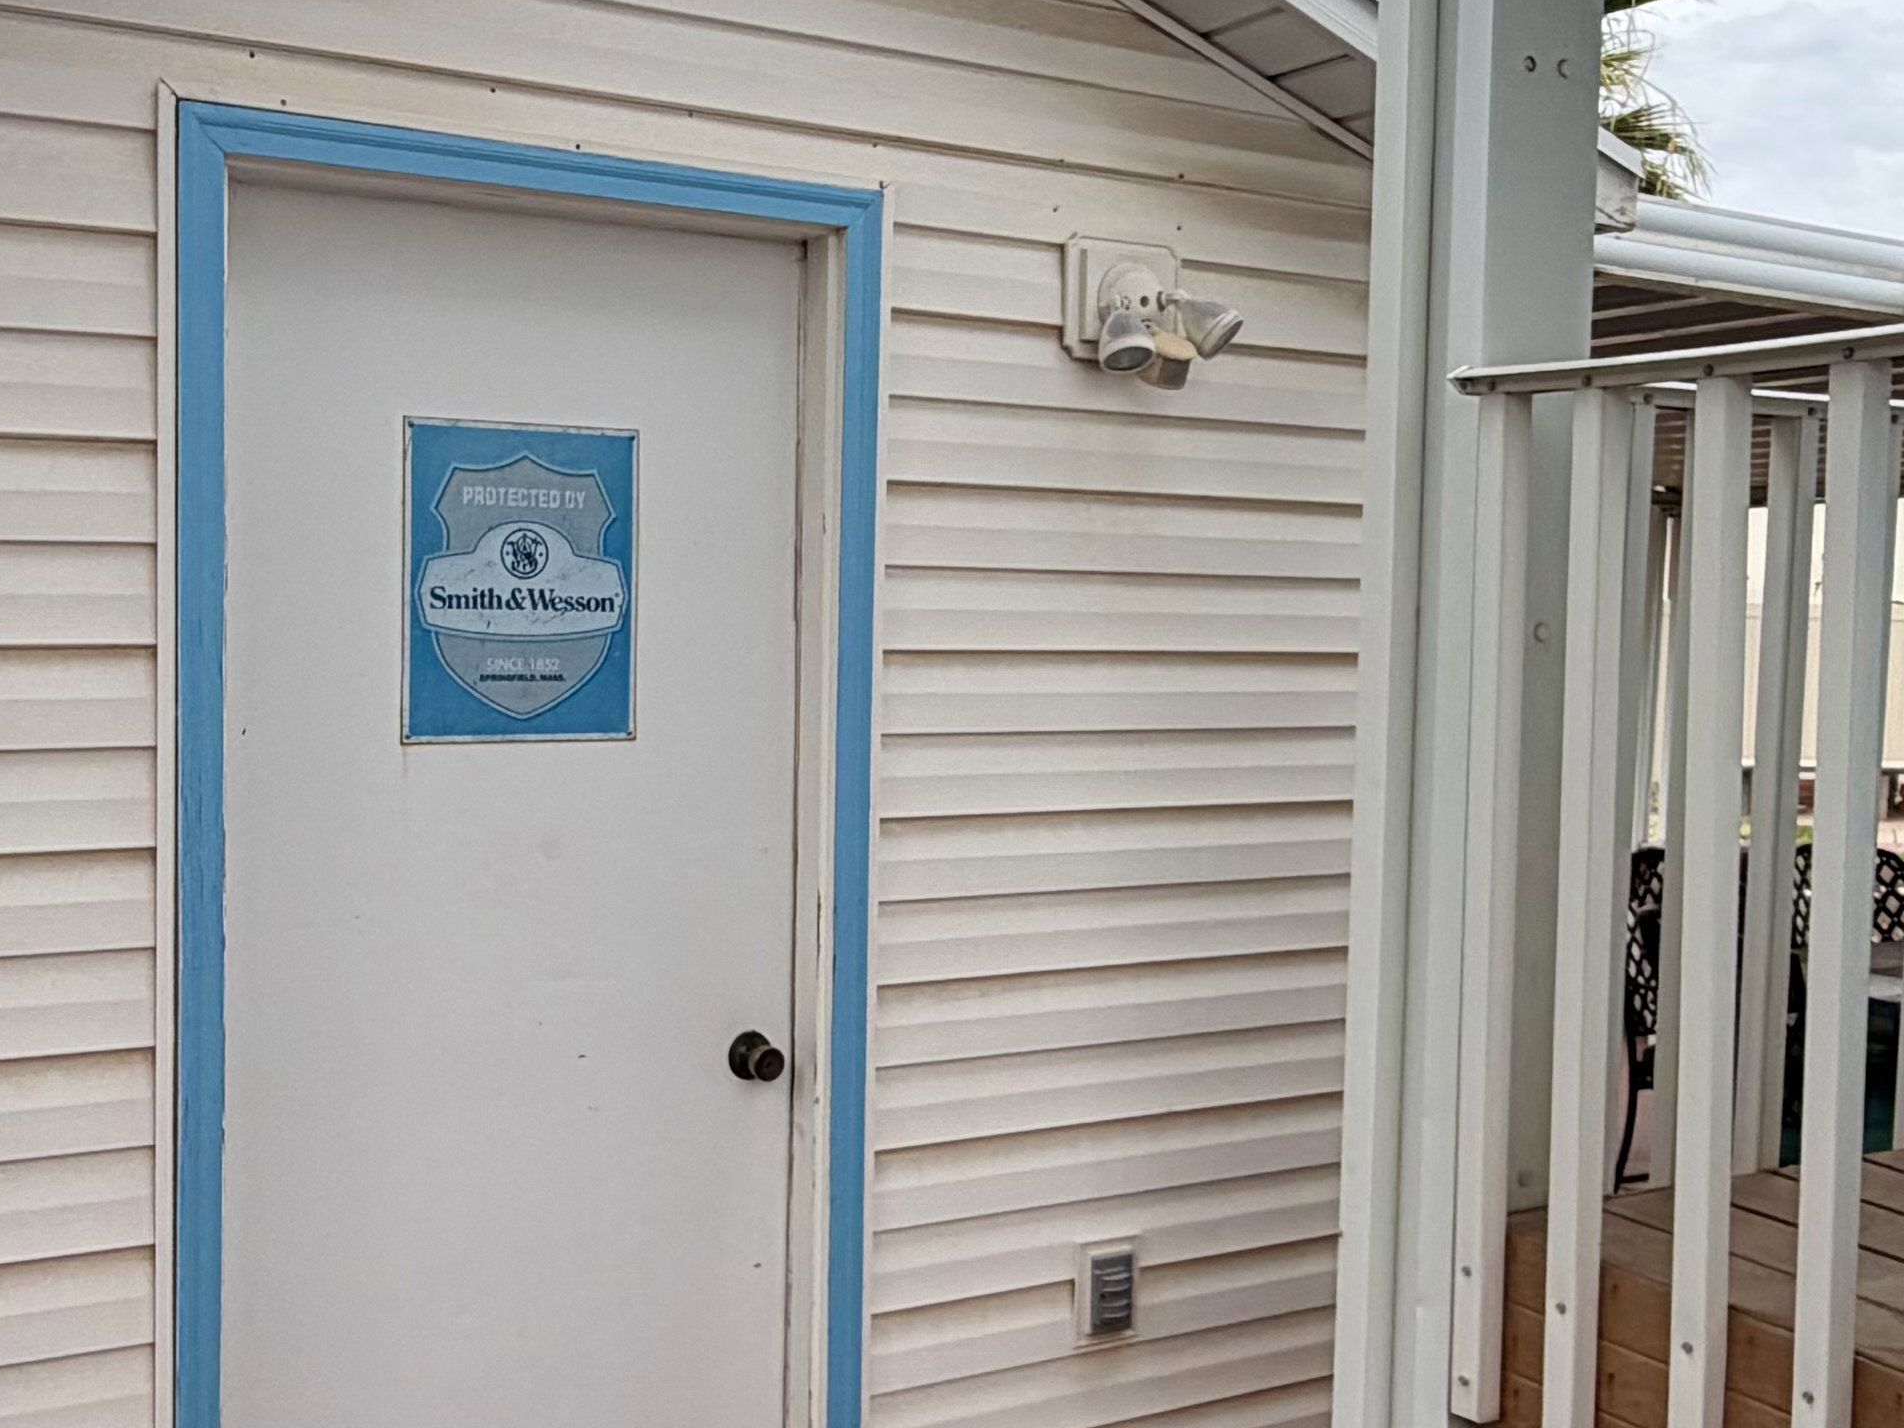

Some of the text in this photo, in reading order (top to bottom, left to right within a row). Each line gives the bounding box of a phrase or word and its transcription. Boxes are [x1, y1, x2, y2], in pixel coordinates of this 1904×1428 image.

[462, 485, 586, 510] PROTECTED BY
[486, 657, 560, 671] SINCE 1852
